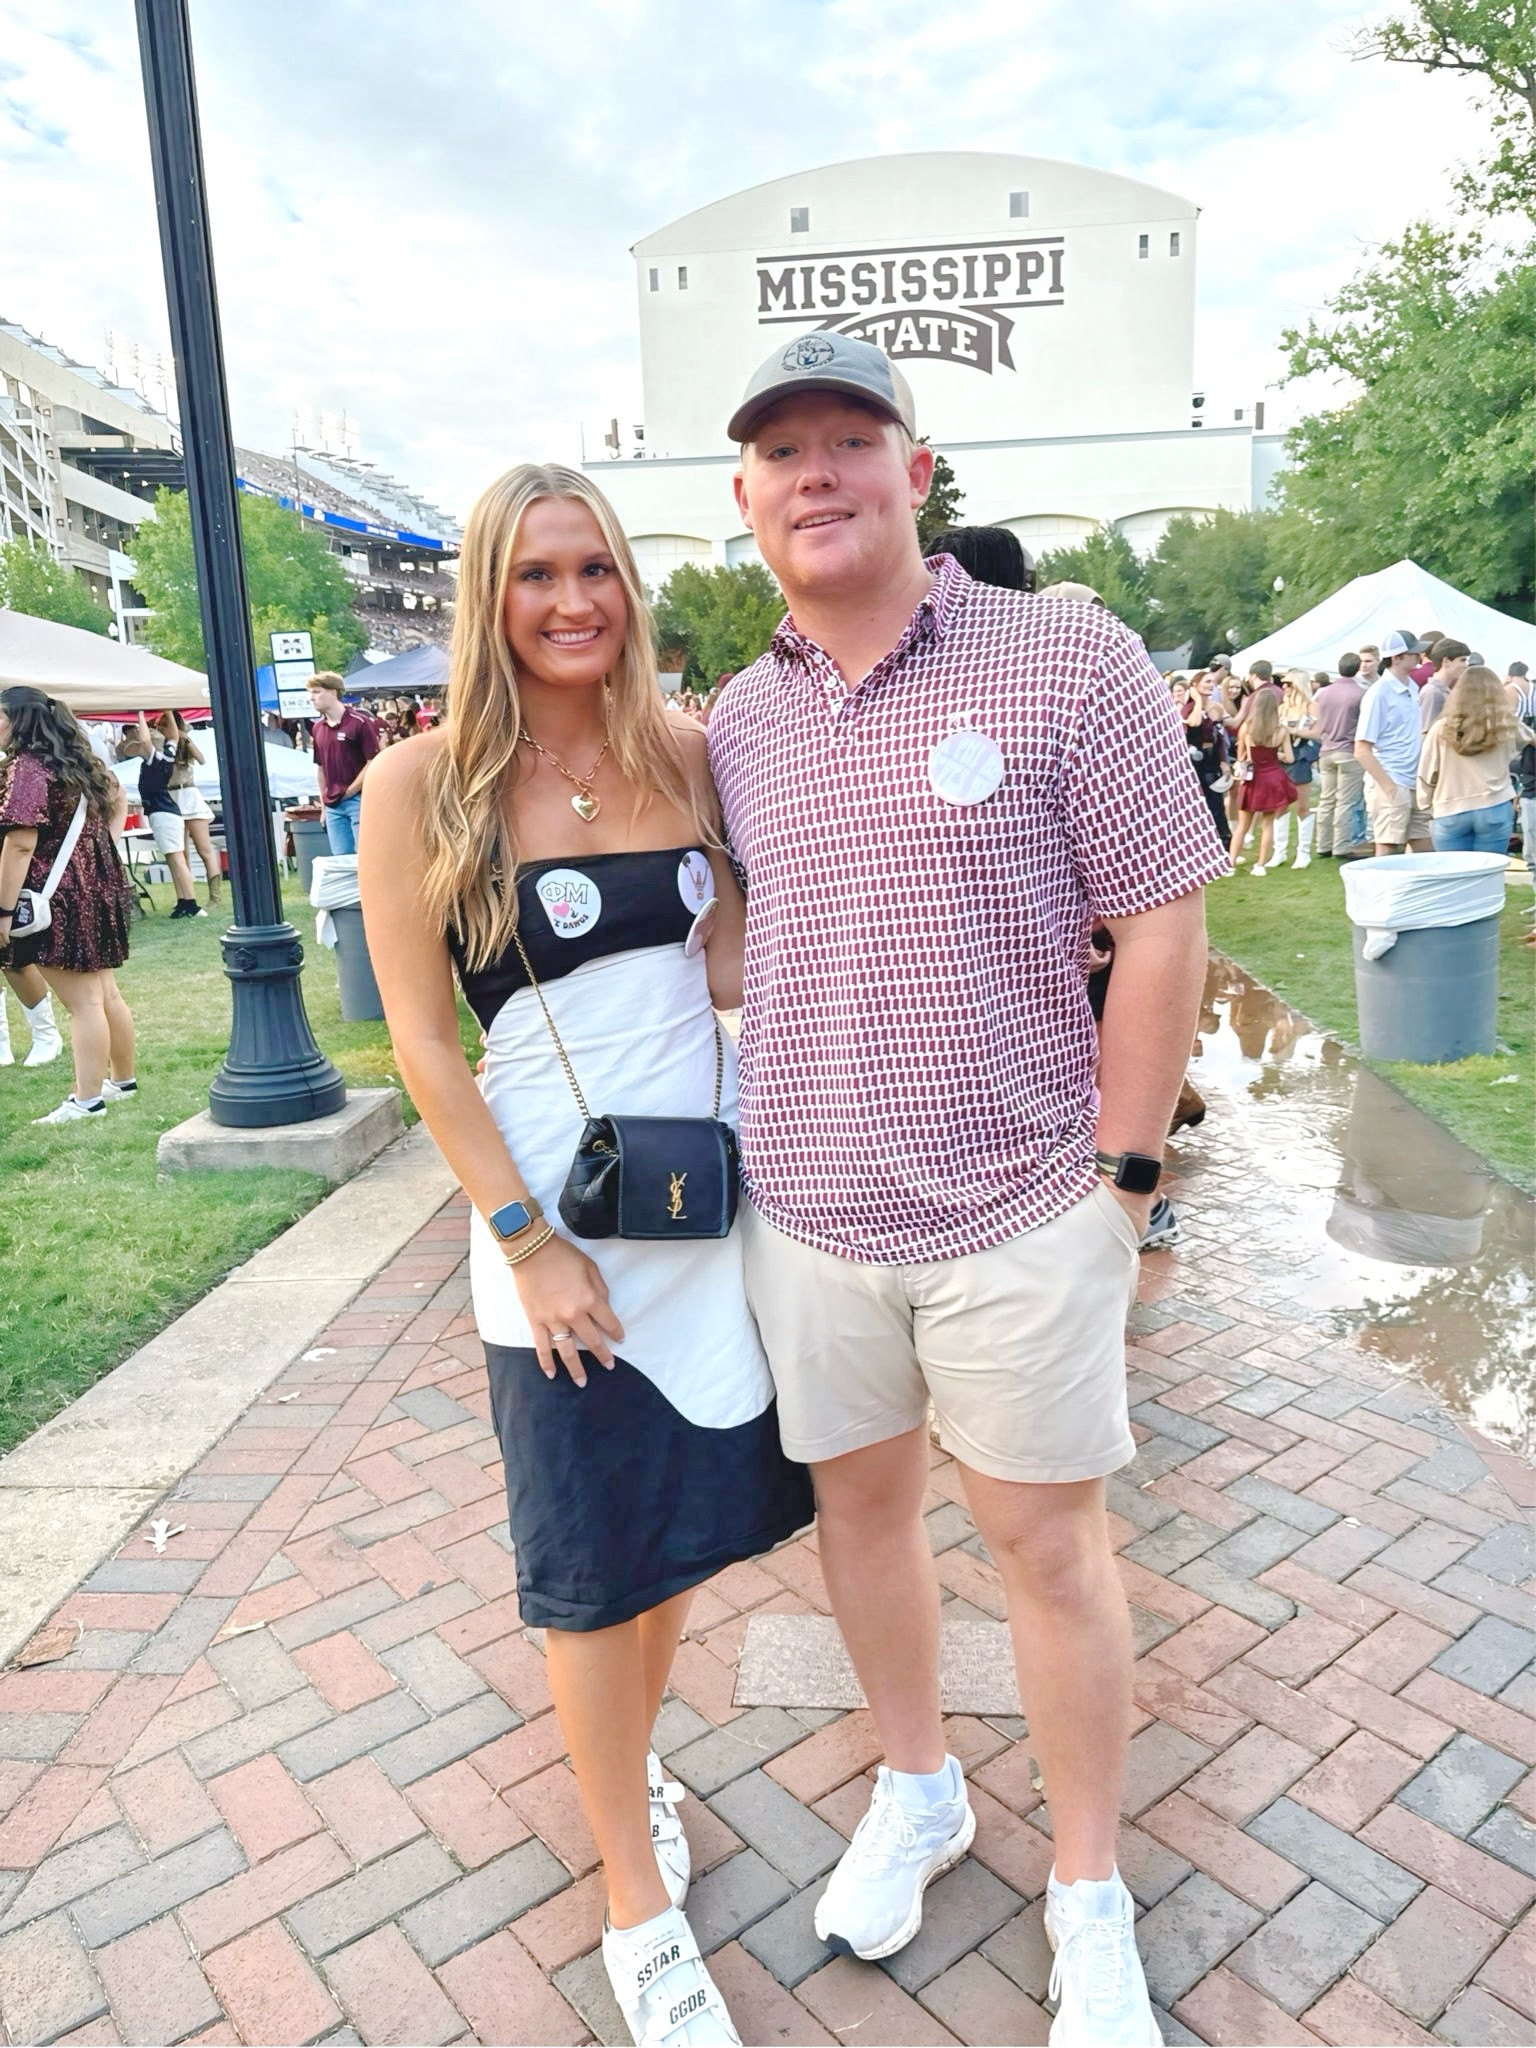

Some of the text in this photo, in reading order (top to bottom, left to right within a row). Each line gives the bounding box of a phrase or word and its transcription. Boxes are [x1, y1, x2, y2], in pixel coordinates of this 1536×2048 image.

[756, 249, 1065, 313] MISSISSIPPI
[637, 1944, 680, 1988] SSTAR
[669, 1989, 707, 2025] GGDB
